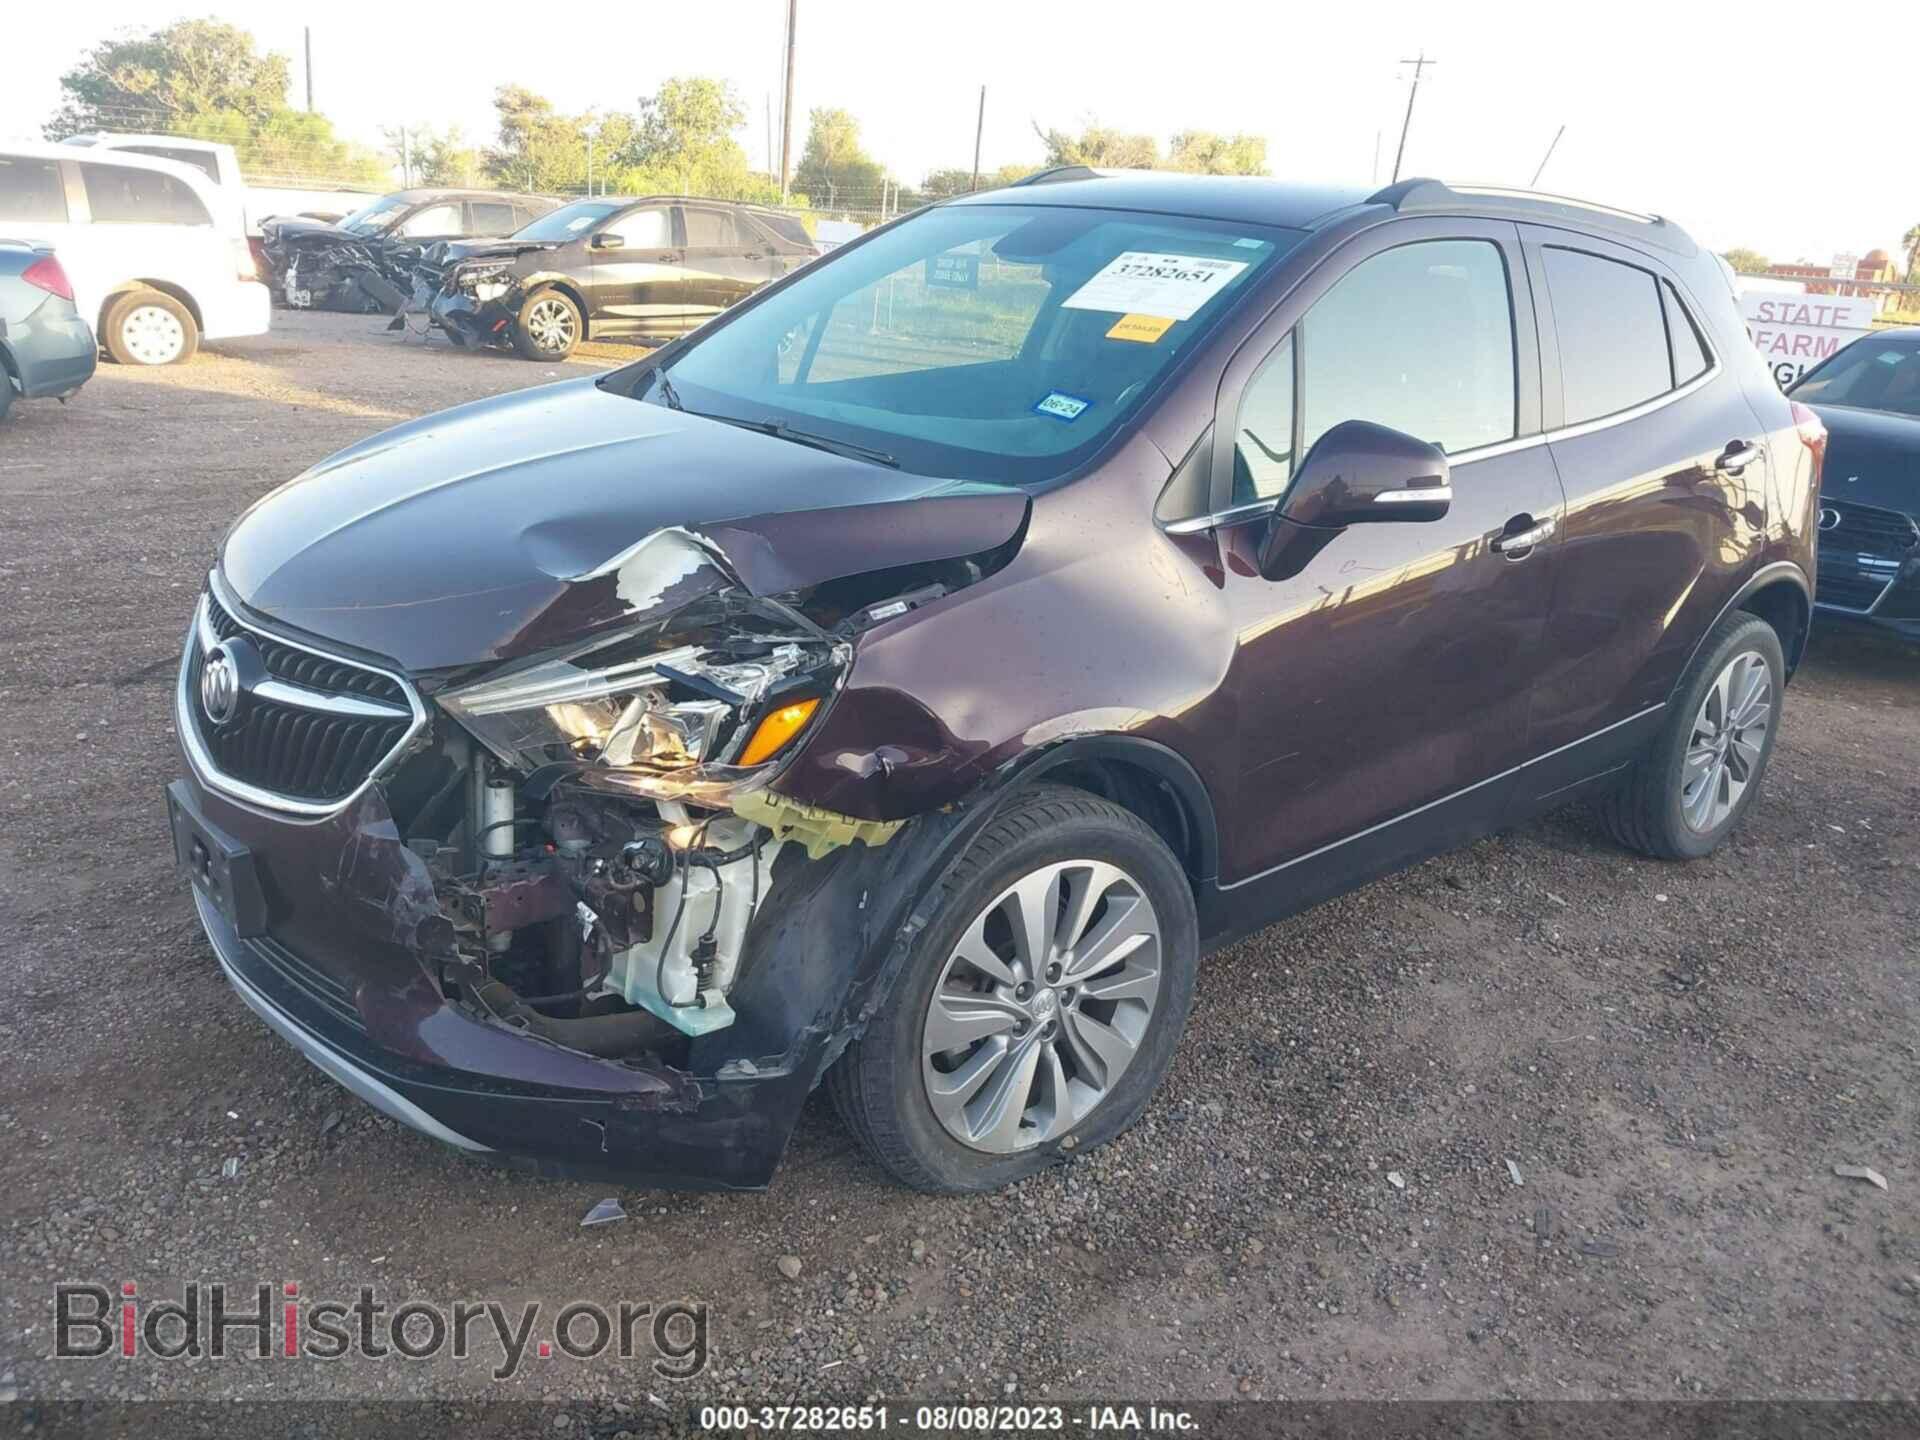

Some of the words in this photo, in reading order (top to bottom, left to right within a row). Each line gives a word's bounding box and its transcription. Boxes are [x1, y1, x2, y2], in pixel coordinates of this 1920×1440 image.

[1112, 263, 1215, 283] 37282651
[1757, 300, 1852, 326] STATE
[1755, 330, 1839, 358] FARM
